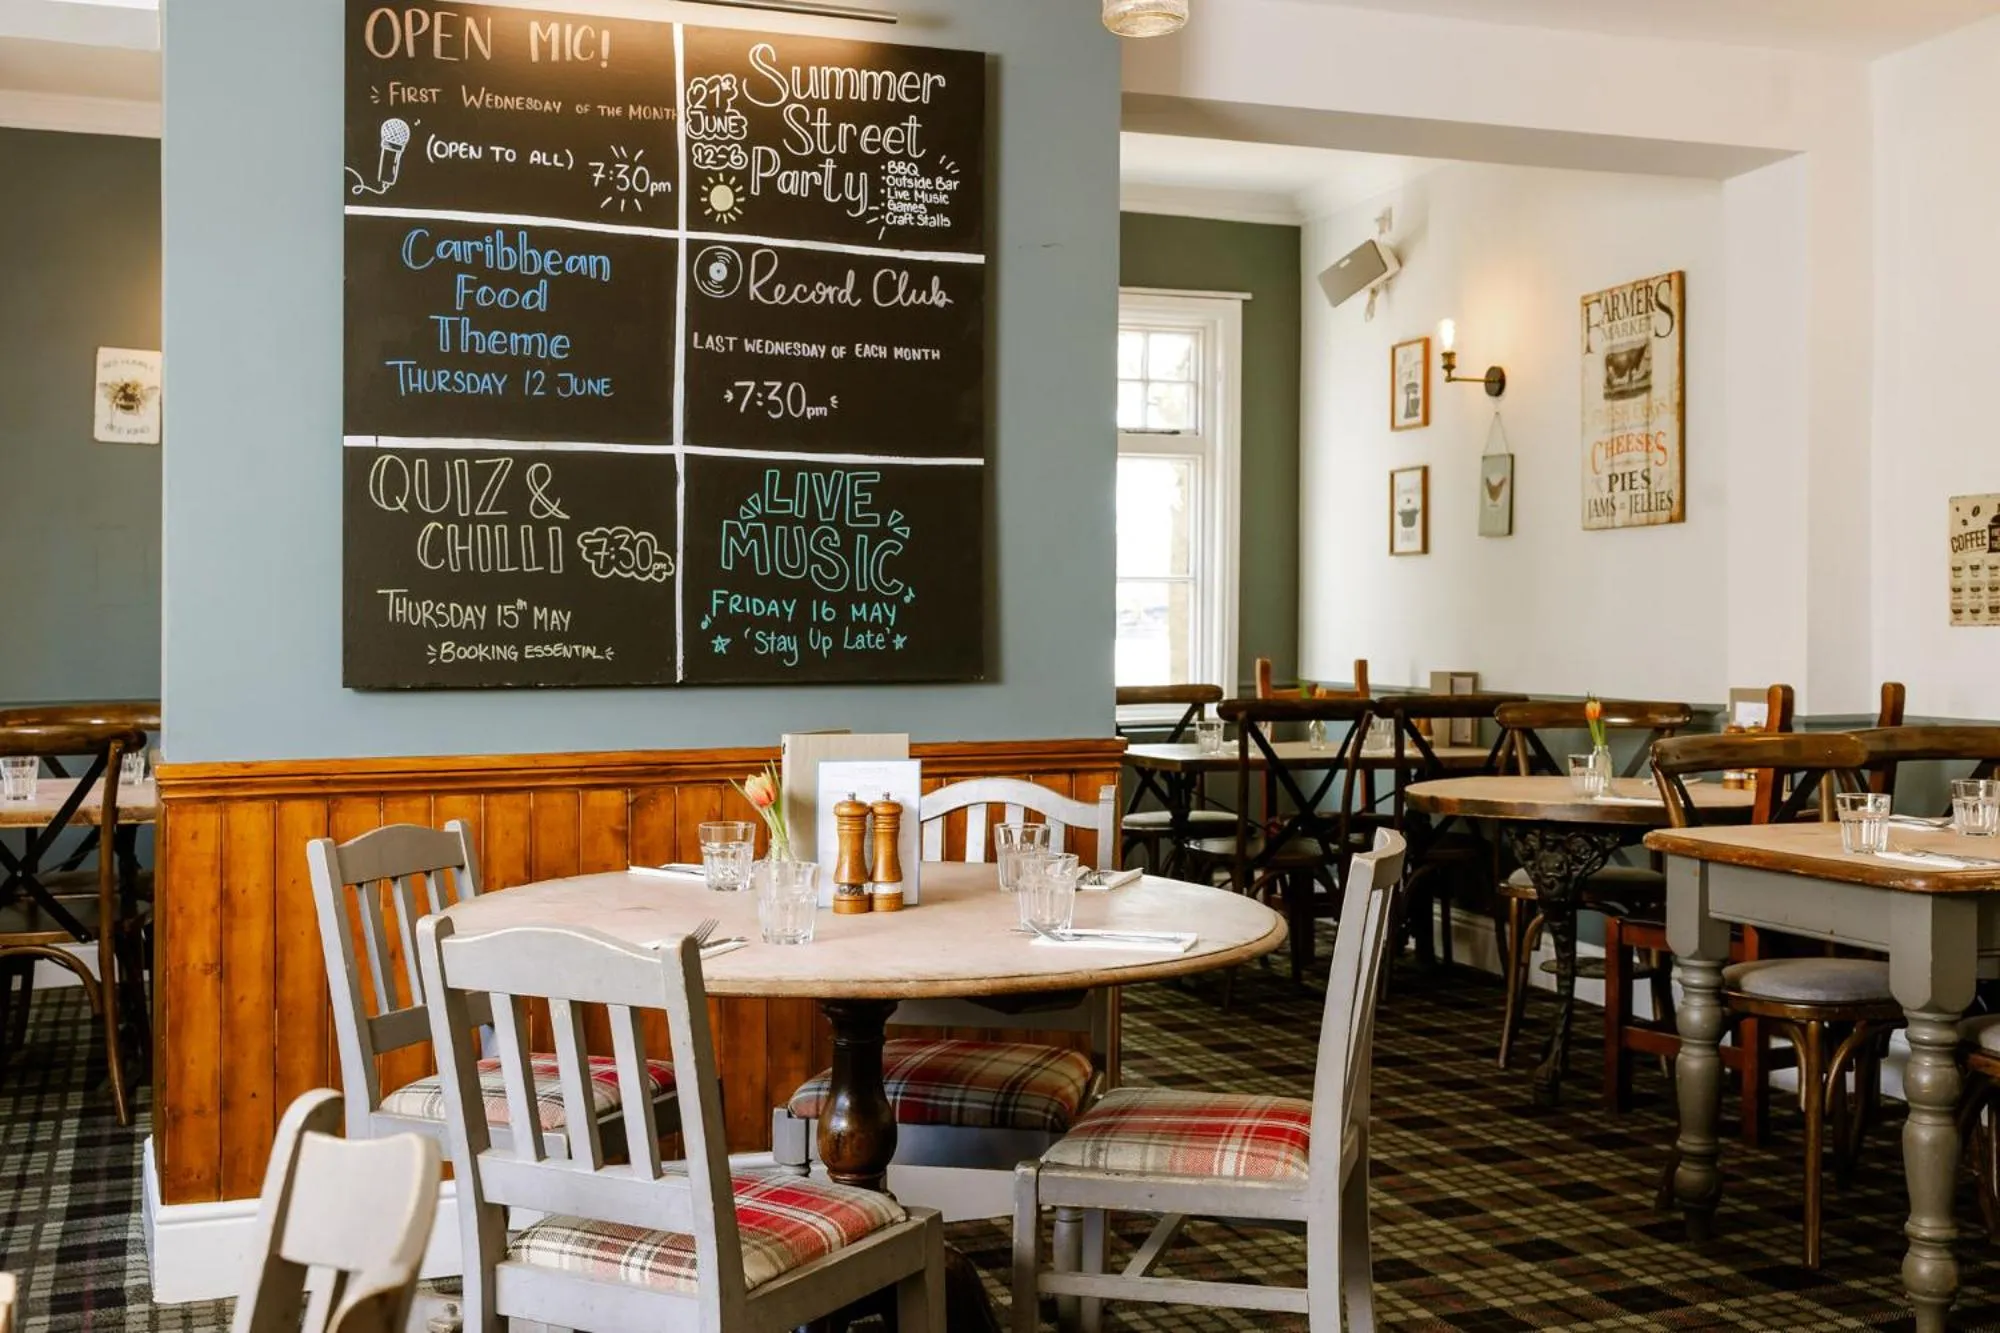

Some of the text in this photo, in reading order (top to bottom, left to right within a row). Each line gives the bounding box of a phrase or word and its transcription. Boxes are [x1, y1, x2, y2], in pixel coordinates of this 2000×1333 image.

[364, 7, 610, 68] OPEN MIC!
[743, 43, 946, 107] Summer
[389, 81, 443, 107] FIRST
[461, 85, 562, 114] WEDNESDAY
[575, 104, 593, 115] OF
[597, 105, 623, 118] THE
[688, 110, 740, 136] JUNE
[783, 103, 926, 158] Street
[426, 134, 574, 171] (OPEN TO ALL)
[698, 148, 743, 166] 12-6
[887, 160, 920, 177] BBQ
[751, 146, 868, 218] Party
[886, 175, 960, 191] Outside Bar
[887, 187, 950, 205] Live Music
[885, 211, 951, 228] Craft Stalls
[887, 199, 928, 214] Games
[401, 228, 611, 282] Caribbean
[455, 274, 548, 312] Food
[749, 249, 954, 308] Record Club
[1583, 279, 1674, 355] FARMERS
[429, 315, 571, 359] Theme
[693, 332, 940, 361] LAST WEDNESDAY OF EACH MONTH
[385, 360, 614, 398] THURSDAY 12 JUNE
[1590, 430, 1668, 476] CHEESES
[368, 454, 571, 520] QUIZ &
[764, 469, 881, 528] LIVE
[1608, 467, 1652, 494] PIES
[1587, 488, 1674, 521] JAMS JELLIES
[416, 522, 564, 574] CHILLI
[720, 519, 905, 596] MUSIC
[1951, 529, 1987, 553] COFFEE
[376, 588, 487, 630] THURSDAY
[533, 605, 572, 632] MAY
[711, 590, 897, 627] FRIDAY 16 MAY
[440, 640, 605, 663] BOOKING ESSENTIAL
[809, 627, 833, 658] Up
